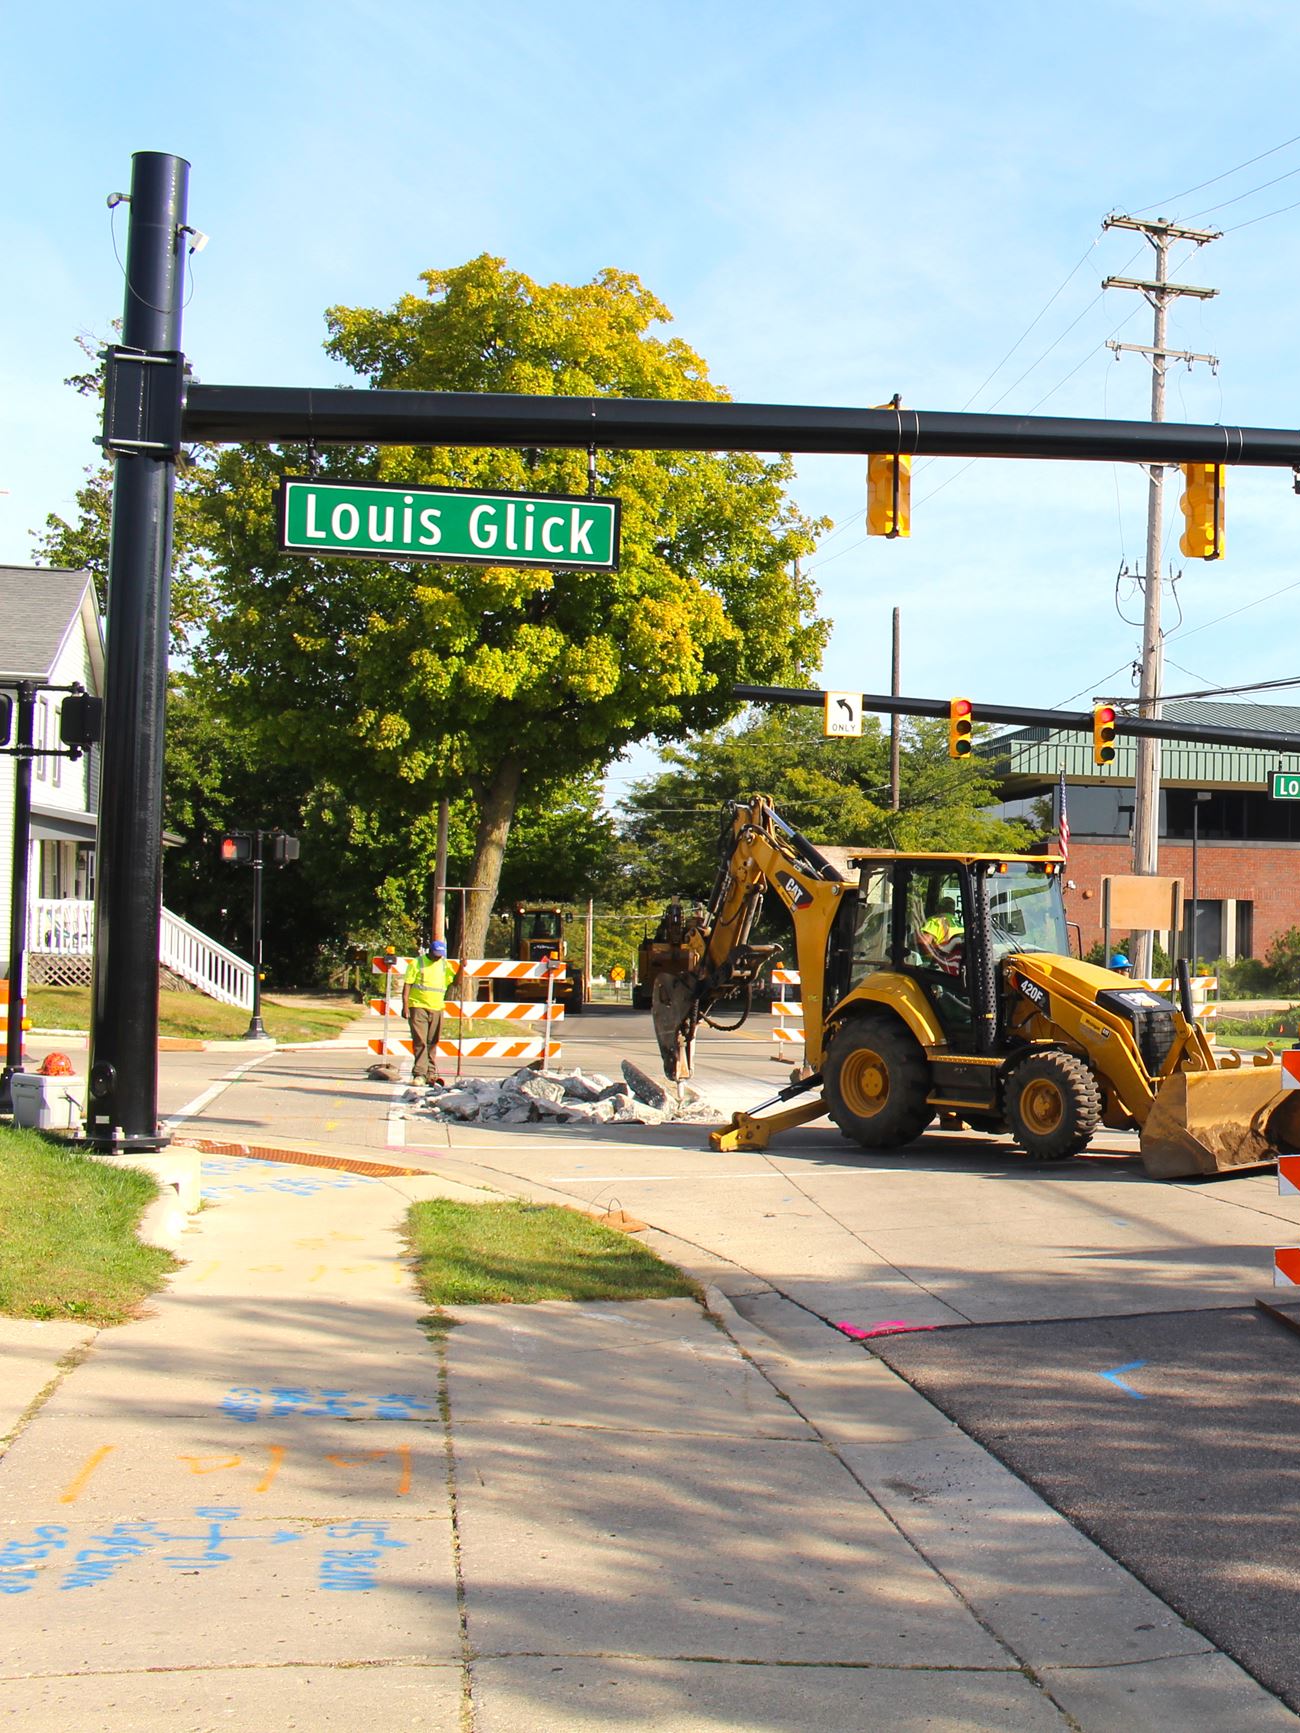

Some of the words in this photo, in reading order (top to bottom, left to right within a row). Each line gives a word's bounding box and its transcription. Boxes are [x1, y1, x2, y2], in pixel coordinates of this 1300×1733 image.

[305, 493, 442, 546] Louis
[467, 502, 595, 555] Glick
[831, 723, 856, 732] ONLY
[785, 877, 804, 903] CAT
[1020, 980, 1043, 1001] 420F
